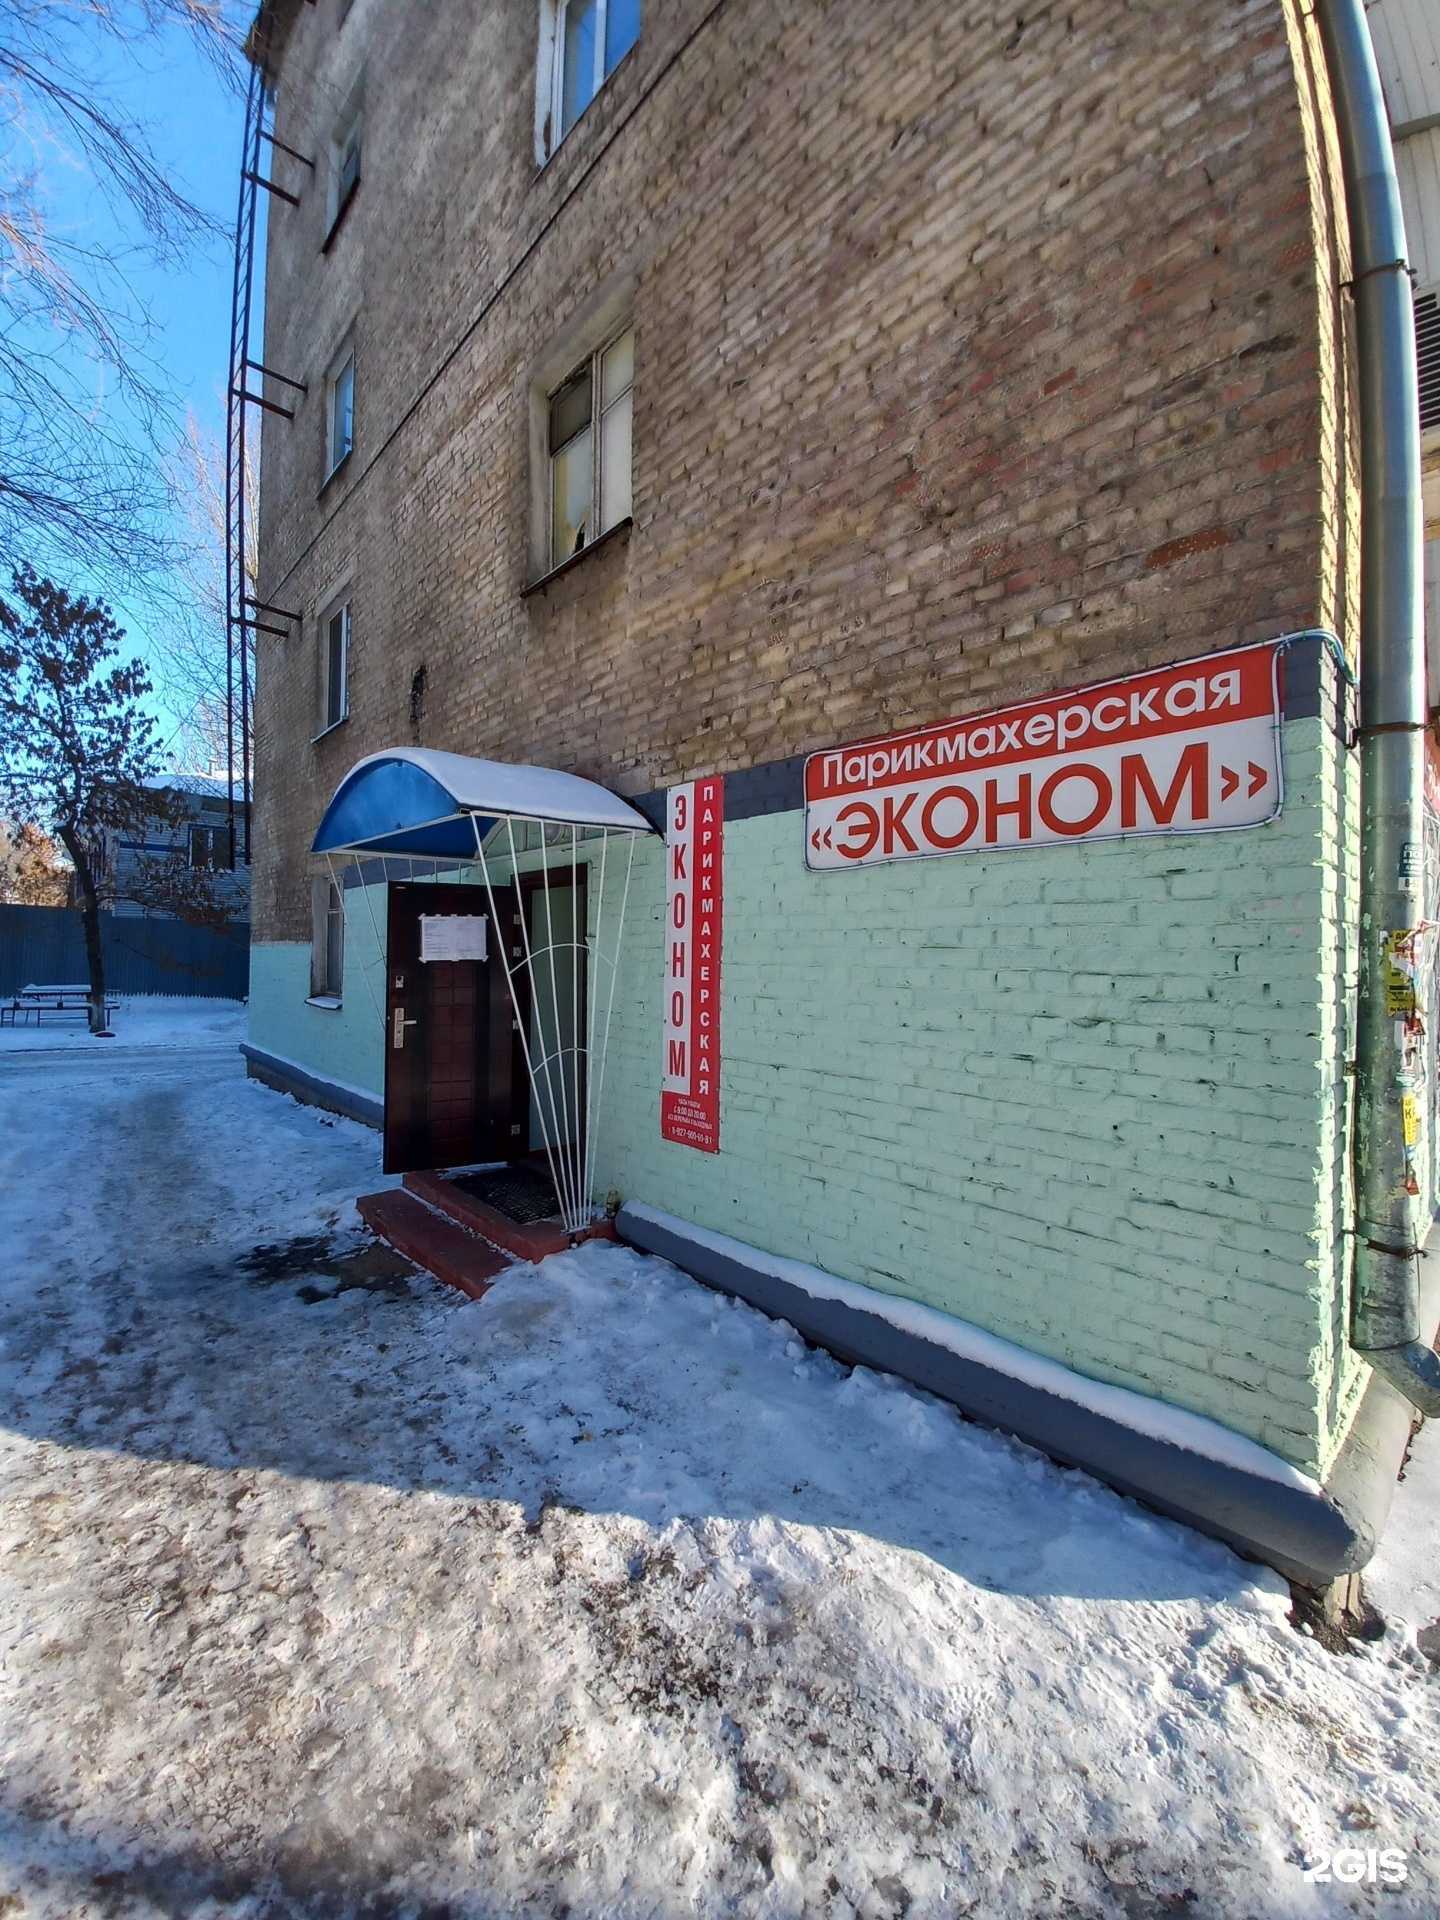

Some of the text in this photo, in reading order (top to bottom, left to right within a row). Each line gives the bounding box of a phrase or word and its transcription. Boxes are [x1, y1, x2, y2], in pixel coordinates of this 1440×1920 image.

[823, 669, 1242, 787] Парикмахерская
[669, 794, 688, 1077] ЭКОНОМ
[699, 785, 714, 1095] ПАРИКМАХЕРСКАЯ
